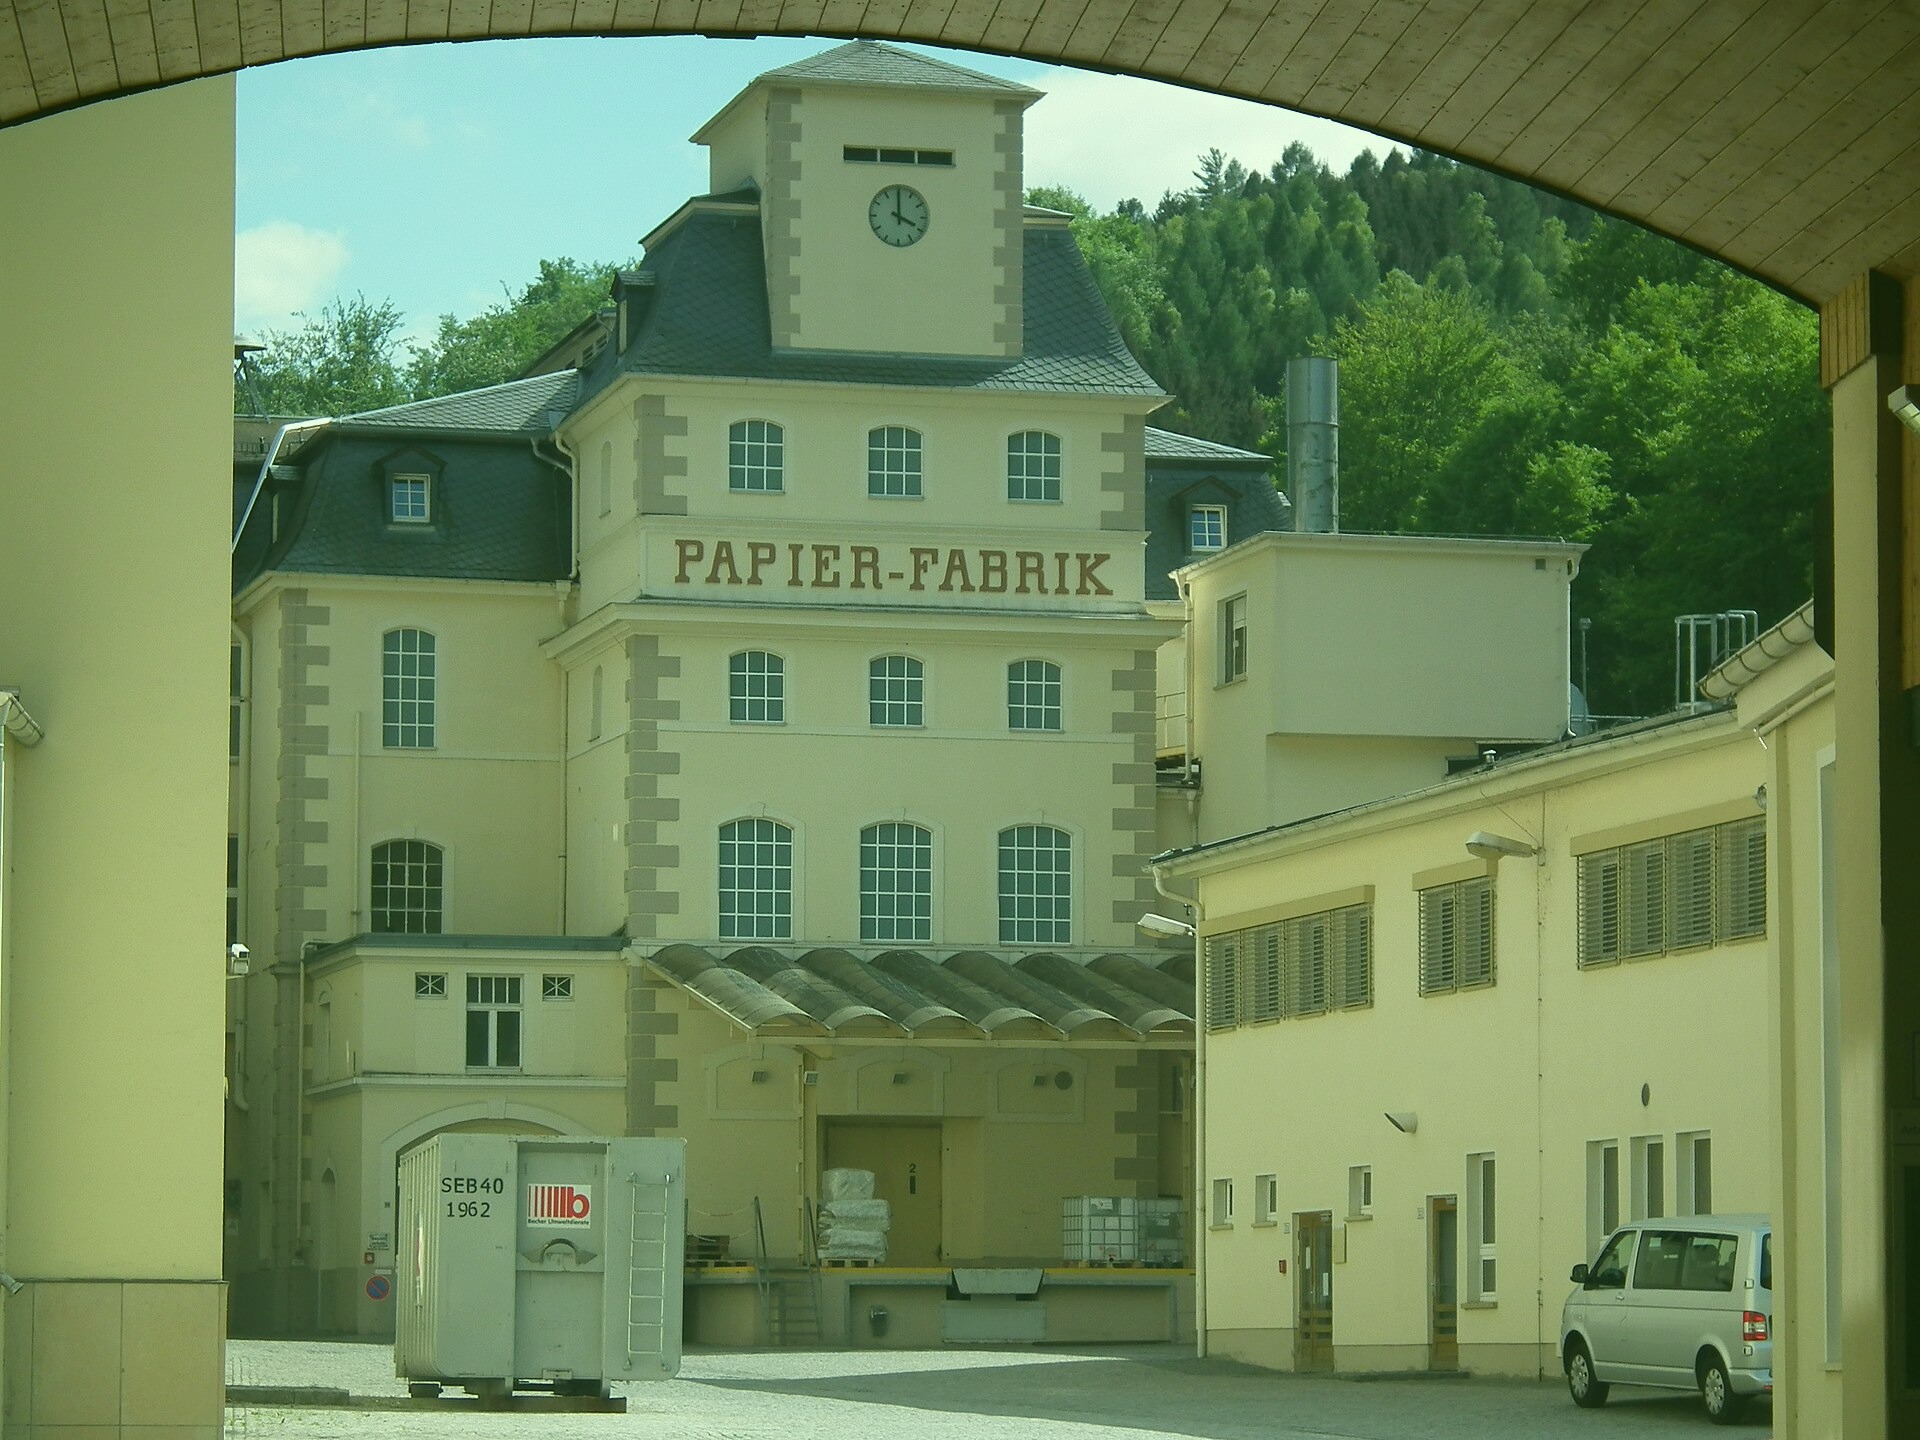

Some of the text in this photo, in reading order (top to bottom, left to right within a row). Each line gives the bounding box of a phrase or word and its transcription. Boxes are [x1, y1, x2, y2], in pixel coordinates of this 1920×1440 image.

[674, 538, 1114, 596] PAPIER-FABRIK
[909, 1163, 917, 1174] 2
[447, 1201, 490, 1218] 1962
